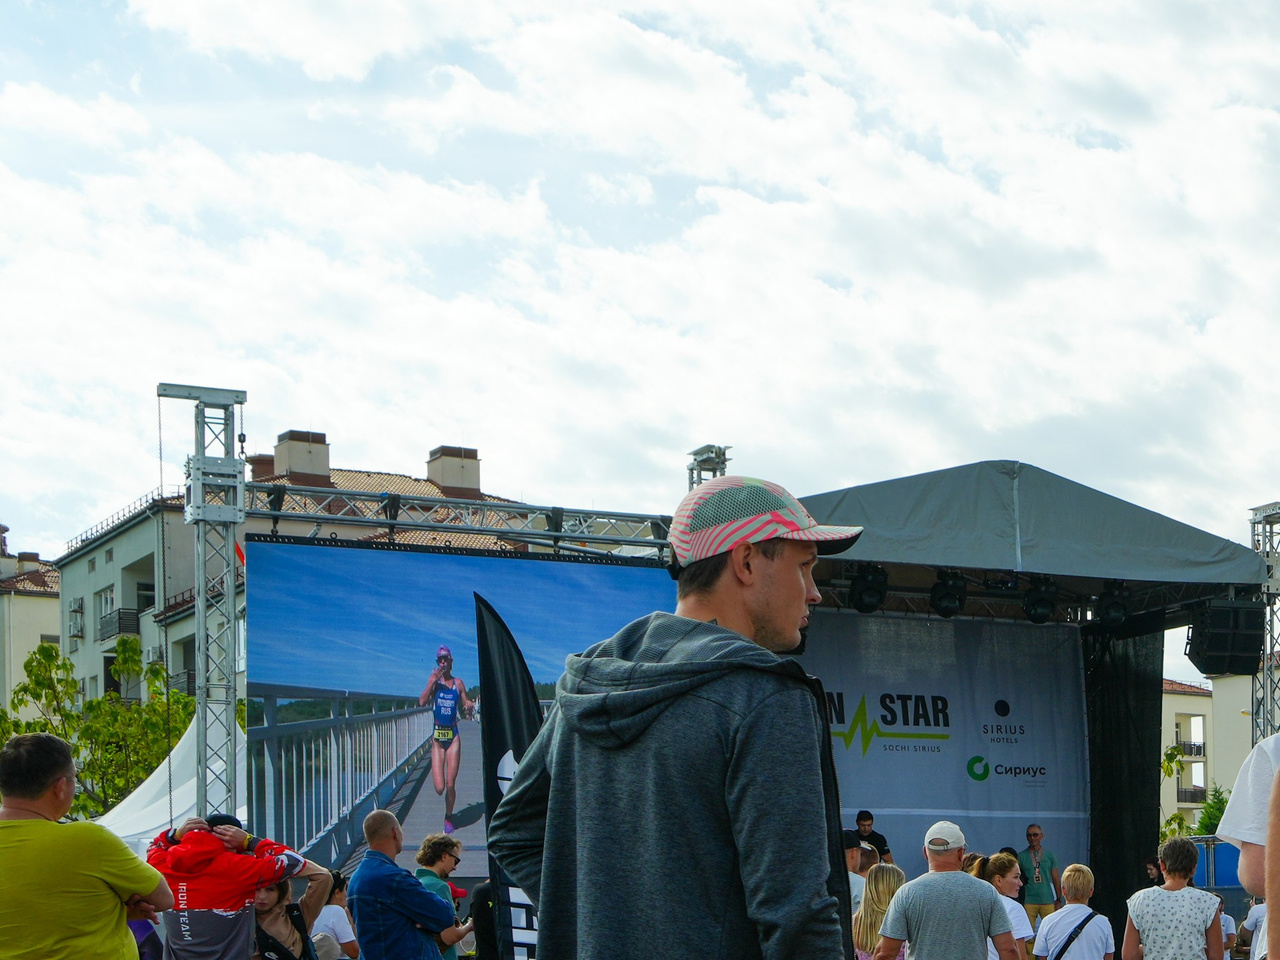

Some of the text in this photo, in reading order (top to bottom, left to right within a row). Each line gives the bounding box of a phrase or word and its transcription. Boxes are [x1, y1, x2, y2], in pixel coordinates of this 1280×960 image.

[880, 693, 950, 727] STAR
[983, 724, 1025, 735] SIRIUS
[883, 744, 941, 753] SOCHI SIRIUS
[994, 764, 1046, 777] Сириус
[178, 883, 192, 941] IRON TEAM
